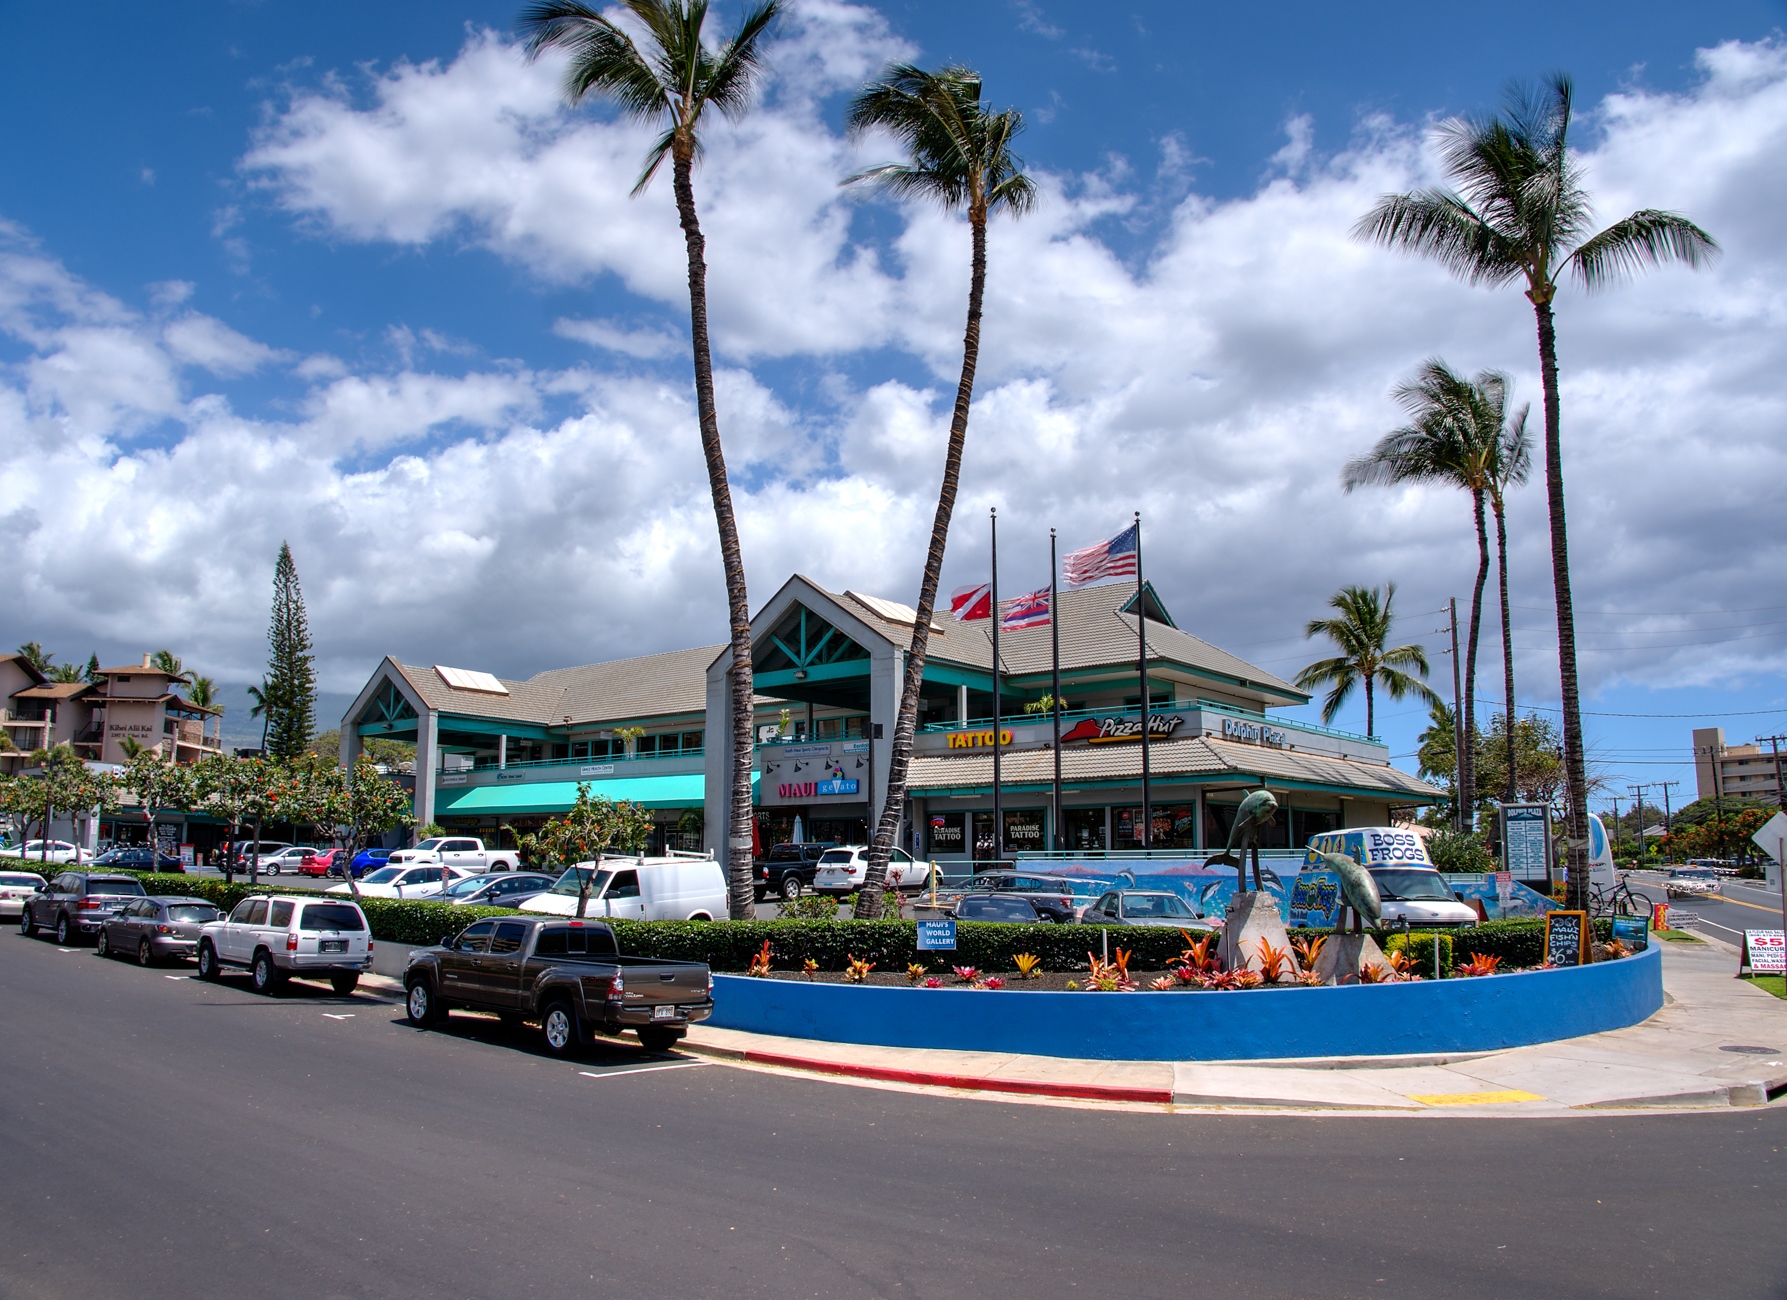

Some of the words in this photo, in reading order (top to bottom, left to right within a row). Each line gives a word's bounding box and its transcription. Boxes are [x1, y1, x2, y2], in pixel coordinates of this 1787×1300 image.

[1099, 719, 1142, 738] Pizza
[1148, 715, 1182, 732] Hut
[1226, 719, 1259, 740] Dolphin
[1261, 725, 1286, 744] Plaza
[946, 731, 1013, 748] TATTOO
[778, 782, 817, 797] MAUI
[822, 781, 857, 793] gelato
[1528, 808, 1543, 817] PLAZA
[1010, 824, 1040, 832] PARADISE
[1011, 831, 1040, 839] TATTOO
[1370, 833, 1416, 847] BOSS
[1368, 847, 1425, 862] FROGS
[1552, 926, 1579, 934] MAUI
[1549, 940, 1577, 948] CHIPS
[1754, 937, 1784, 946] $5
